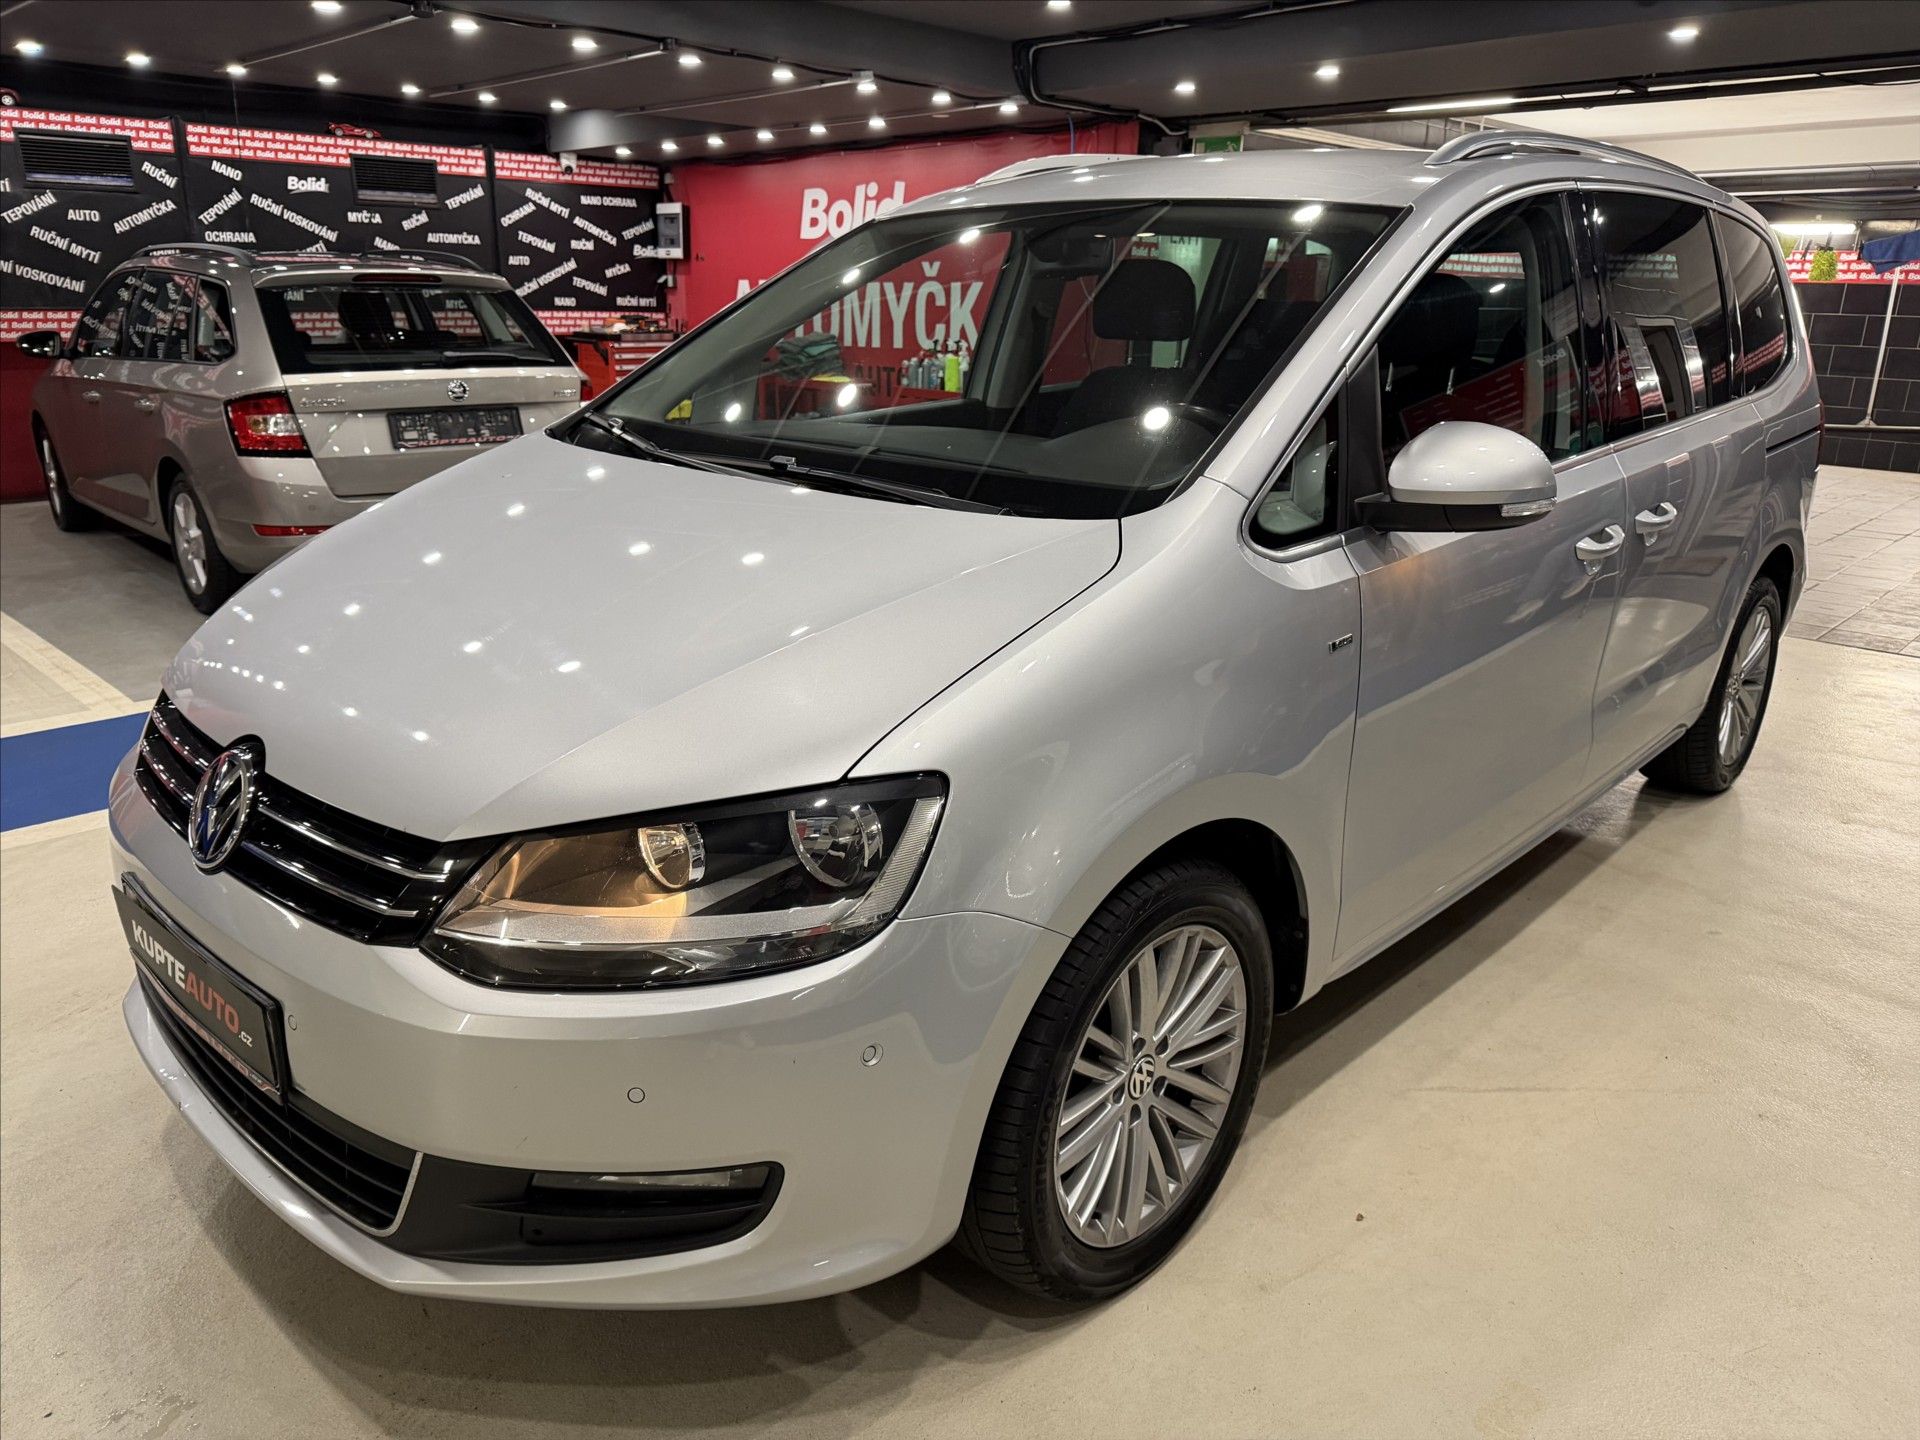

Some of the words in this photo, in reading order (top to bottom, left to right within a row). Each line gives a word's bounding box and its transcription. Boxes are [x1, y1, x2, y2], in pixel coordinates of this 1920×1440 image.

[22, 111, 45, 120] Bolid
[49, 113, 70, 122] Bolid
[75, 115, 96, 124] Bolid
[100, 117, 121, 126] Bolid
[124, 119, 145, 128] Bolid
[148, 120, 169, 130] Bolid
[139, 131, 160, 140] Bolid
[151, 141, 172, 150] Bolid
[141, 161, 179, 189] RUČNÍ
[211, 160, 243, 181] NANO
[287, 175, 327, 192] Bolid
[0, 190, 57, 224] TEPOVÁNÍ
[198, 187, 243, 225] TEPOVÁNÍ
[444, 183, 485, 210] TEPOVÁNÍ
[525, 187, 551, 208] RUČNÍ
[549, 201, 571, 219] MYTÍ
[580, 194, 601, 206] NANO
[602, 196, 637, 208] OCHRANA
[67, 209, 101, 222] AUTO
[113, 199, 177, 234] AUTOMYČKA
[250, 193, 284, 216] RUČNÍ
[283, 208, 339, 243] VOSKOVÁNÍ
[401, 210, 430, 231] RUČNÍ
[800, 181, 906, 240] Bolid
[205, 231, 256, 243] OCHRANA
[427, 232, 481, 245] AUTOMYČKA
[573, 216, 617, 247] AUTOMYČKA
[621, 218, 655, 240] TEPOVÁNÍ
[29, 225, 71, 251] RUČNÍ
[69, 243, 102, 264] MYTÍ
[517, 230, 556, 253] TEPOVÁNÍ
[508, 255, 531, 266] AUTO
[15, 264, 86, 293] VOSKOVÁNÍ
[572, 276, 608, 297] TEPOVÁNÍ
[554, 296, 577, 307] NANO
